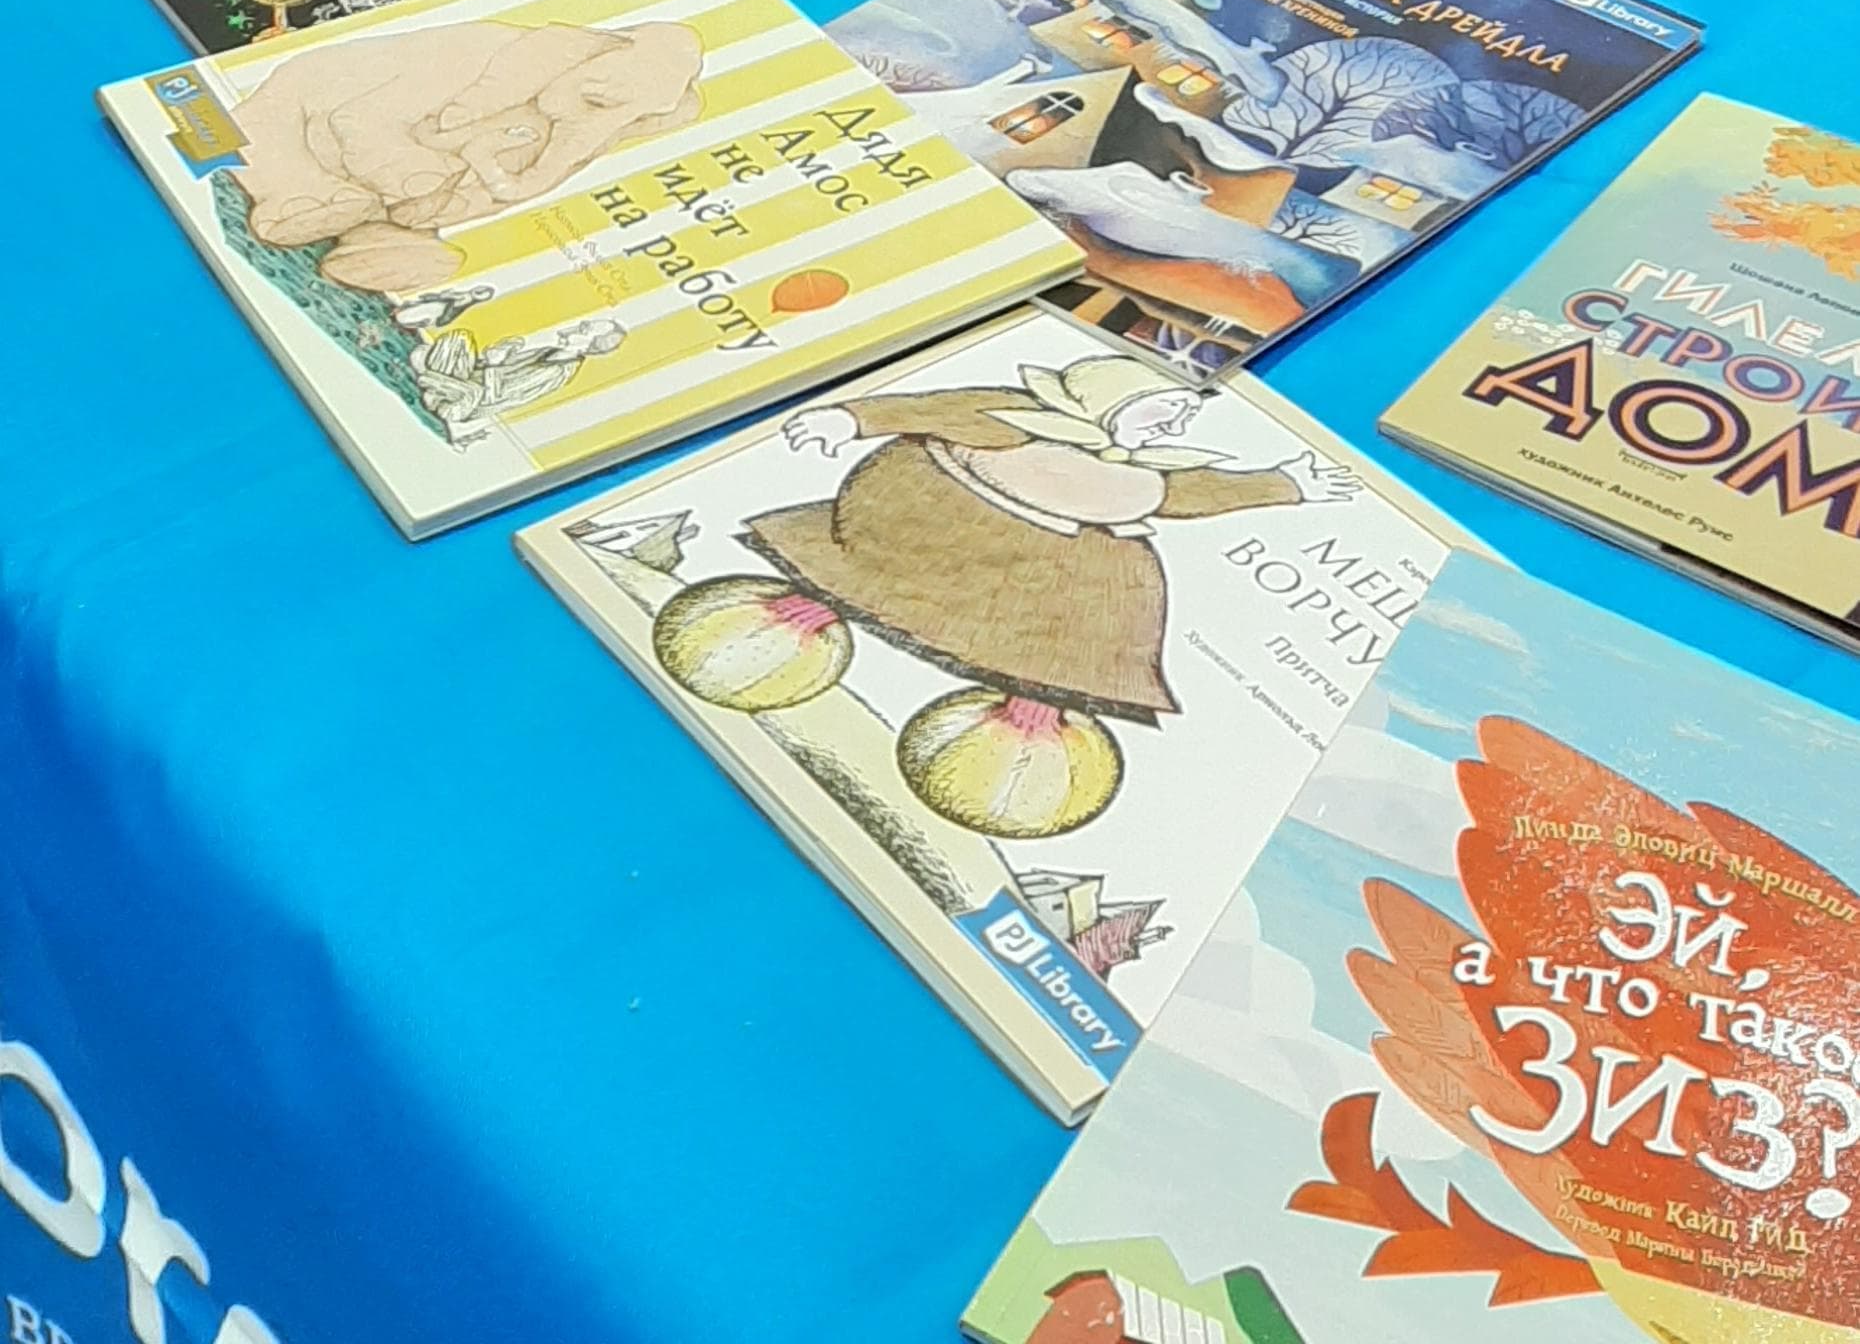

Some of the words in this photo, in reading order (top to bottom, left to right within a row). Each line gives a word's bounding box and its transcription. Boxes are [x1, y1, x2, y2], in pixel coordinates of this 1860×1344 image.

[711, 143, 765, 185] не
[760, 129, 869, 213] Амос
[814, 107, 932, 189] Дядя
[590, 185, 649, 229] на
[653, 163, 749, 240] идёт
[622, 235, 780, 354] работу
[1461, 337, 1860, 541] ДОМ
[1516, 446, 1607, 490] художник
[1220, 536, 1386, 665] ВОРЧУ
[1263, 634, 1351, 709] Притча
[1598, 870, 1771, 992] ЭЙ,
[995, 921, 1036, 953] PJ
[1026, 952, 1129, 1051] Library
[1452, 940, 1497, 987] а
[1528, 955, 1662, 1018] что
[1689, 991, 1860, 1090] тако
[1467, 1004, 1860, 1221] ЗИЗ?
